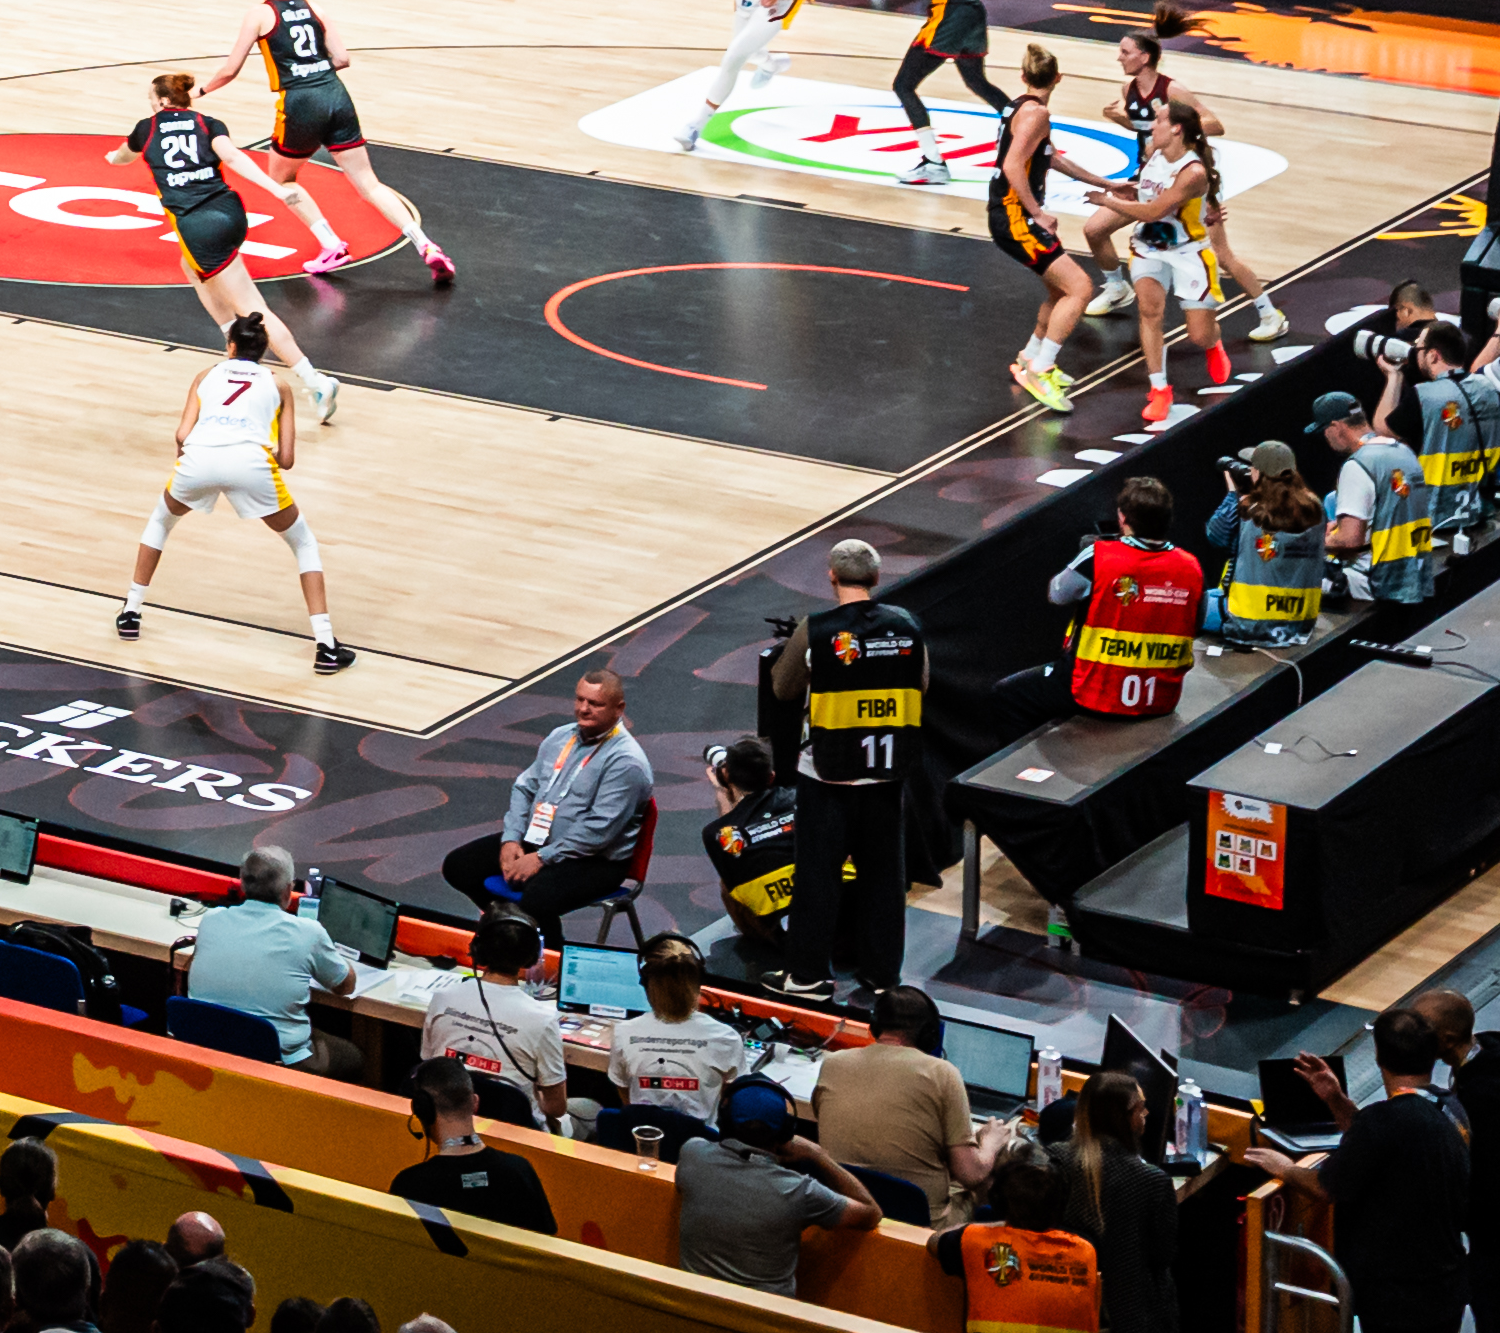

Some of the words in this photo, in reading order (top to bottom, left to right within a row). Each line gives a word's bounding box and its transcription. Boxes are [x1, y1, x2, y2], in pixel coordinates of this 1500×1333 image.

[289, 24, 318, 57] 21
[161, 134, 200, 169] 24
[222, 379, 252, 406] 7
[1100, 636, 1141, 654] TEAM
[1121, 674, 1157, 706] 01
[857, 698, 897, 719] FIBA
[861, 734, 894, 769] 11
[764, 876, 795, 904] FIB
